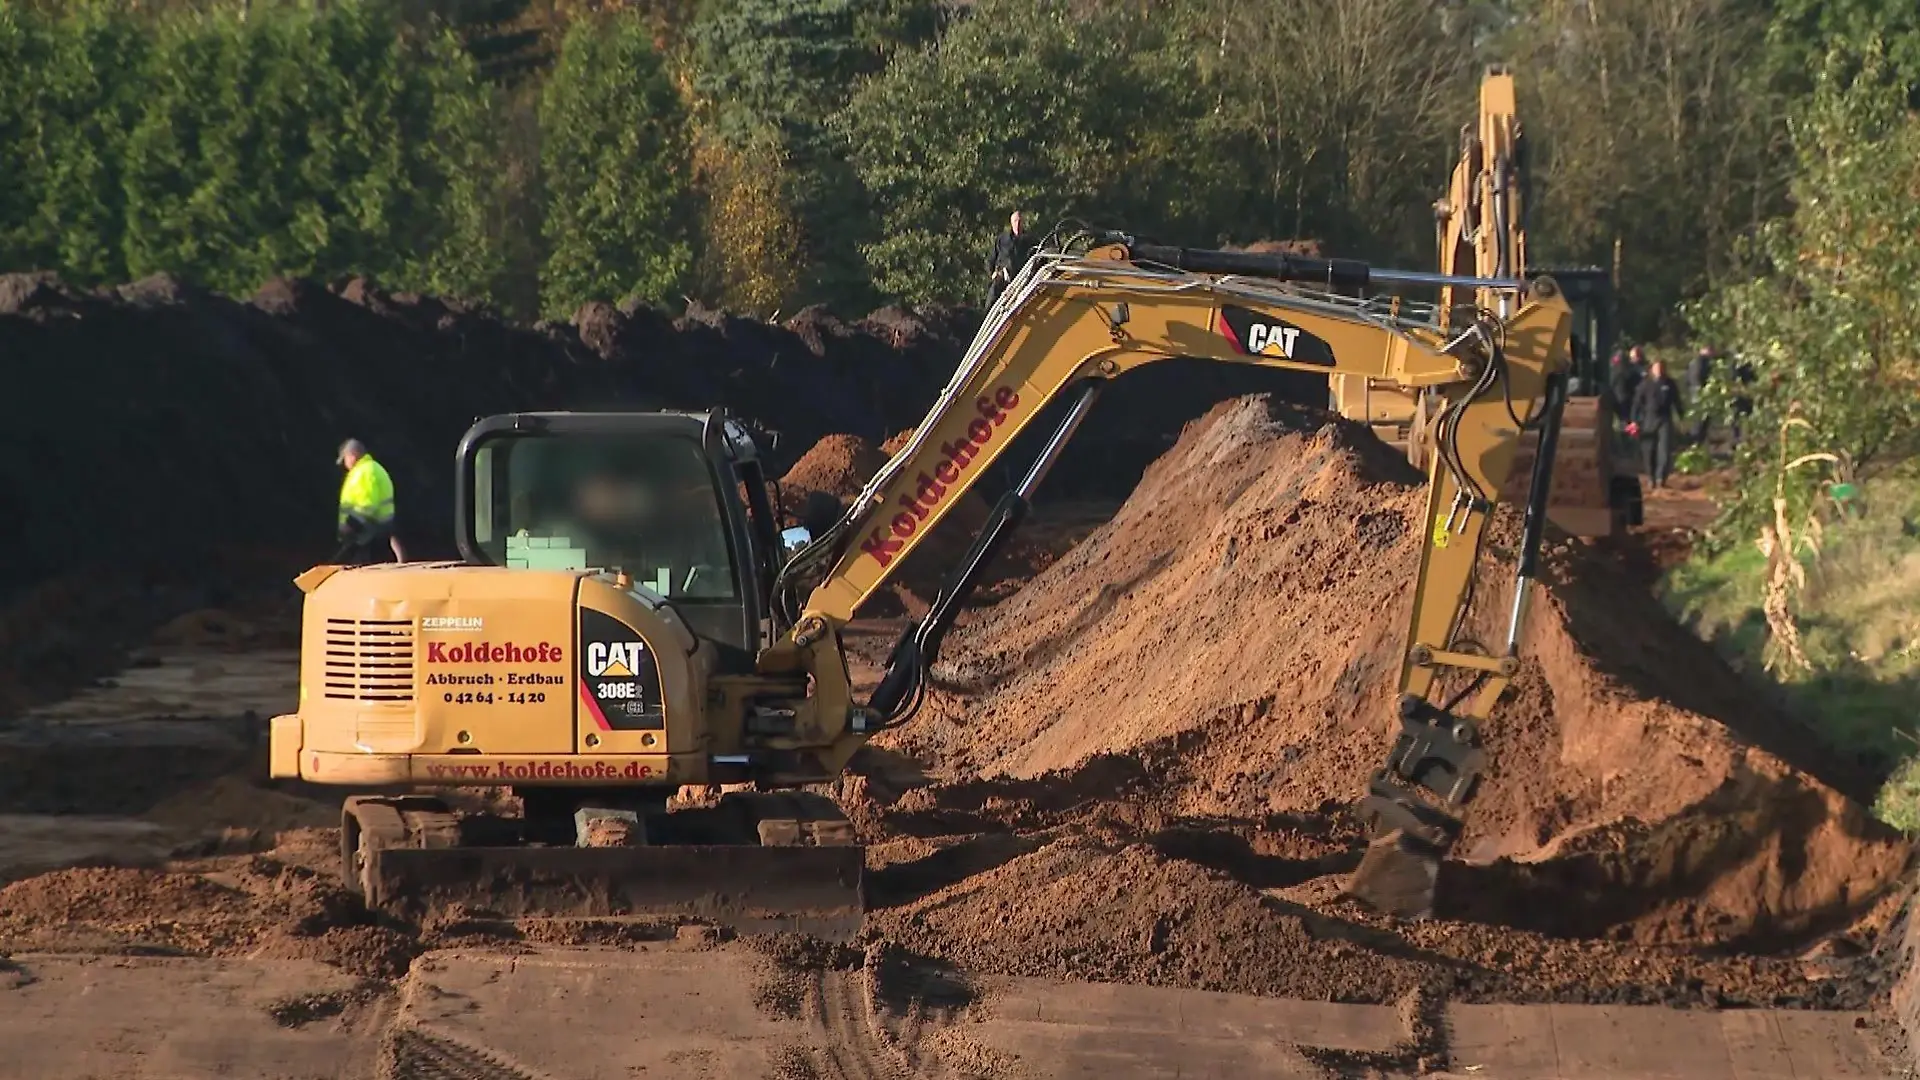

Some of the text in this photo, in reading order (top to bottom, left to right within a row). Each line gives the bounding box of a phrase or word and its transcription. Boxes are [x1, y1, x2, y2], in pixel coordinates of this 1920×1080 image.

[1248, 323, 1300, 359] CAT
[860, 386, 1019, 568] Koldehofe
[422, 617, 482, 628] ZEPPELIN
[427, 642, 563, 663] Koldehofe
[587, 642, 644, 677] CAT
[426, 673, 494, 685] Abbruch
[507, 673, 564, 685] Erdbau
[426, 761, 652, 780] www.koldehofe.de
